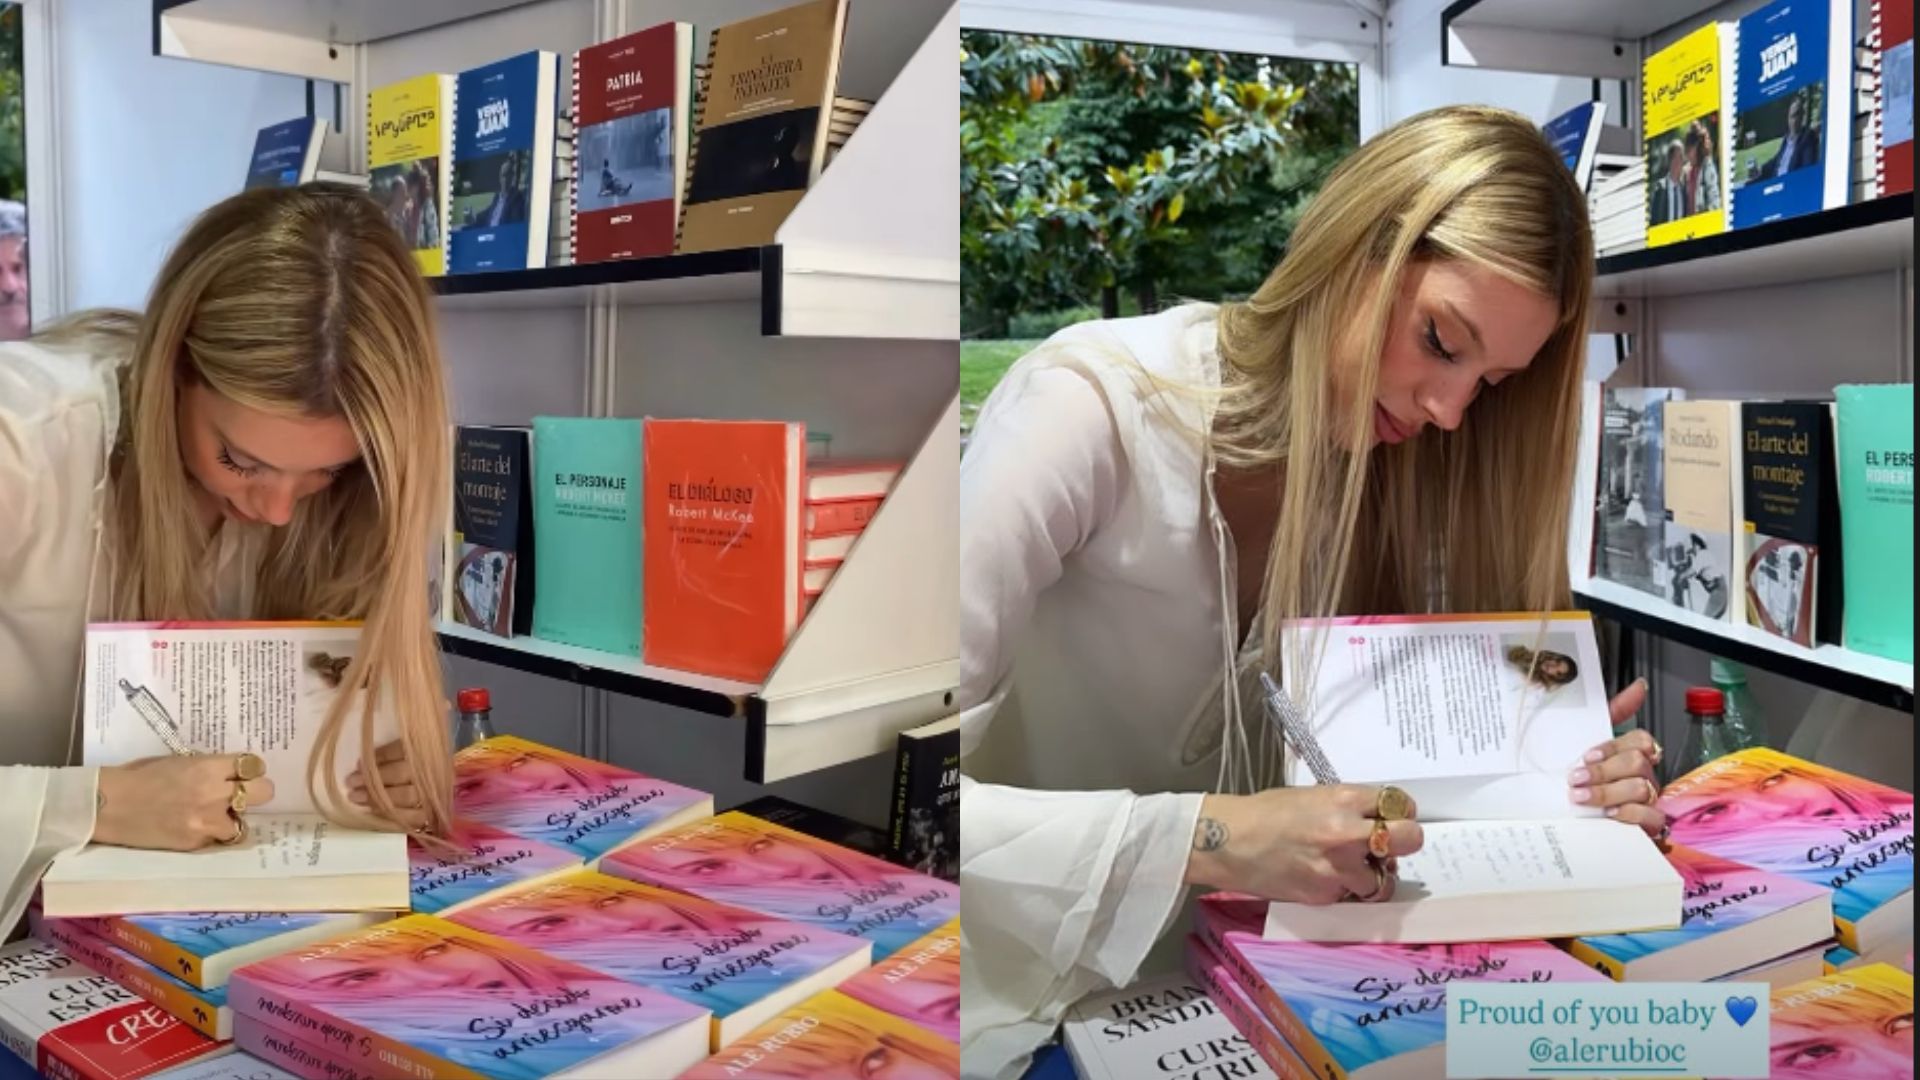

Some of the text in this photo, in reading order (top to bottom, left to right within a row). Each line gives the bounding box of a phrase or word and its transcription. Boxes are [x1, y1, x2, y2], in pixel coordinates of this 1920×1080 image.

[1759, 46, 1797, 83] JUAN
[606, 69, 643, 93] PATRIA
[475, 111, 509, 138] JUAN
[1669, 428, 1719, 450] Rodando
[1746, 430, 1809, 455] El arte del
[1865, 450, 1880, 466] EL
[555, 473, 627, 490] EL PERSONAJE
[668, 477, 753, 504] EL DIÁLOGO
[1752, 463, 1805, 491] montaje
[668, 503, 754, 523] Robert McKee
[1807, 809, 1912, 868] Si decido
[816, 899, 853, 922] Si
[661, 927, 763, 975] Si decido
[882, 934, 959, 984] ALE RUBIO
[1353, 977, 1403, 1002] Si
[1414, 955, 1508, 986] decido
[468, 986, 591, 1040] Si decido
[723, 1015, 820, 1077] ALE RUBIO
